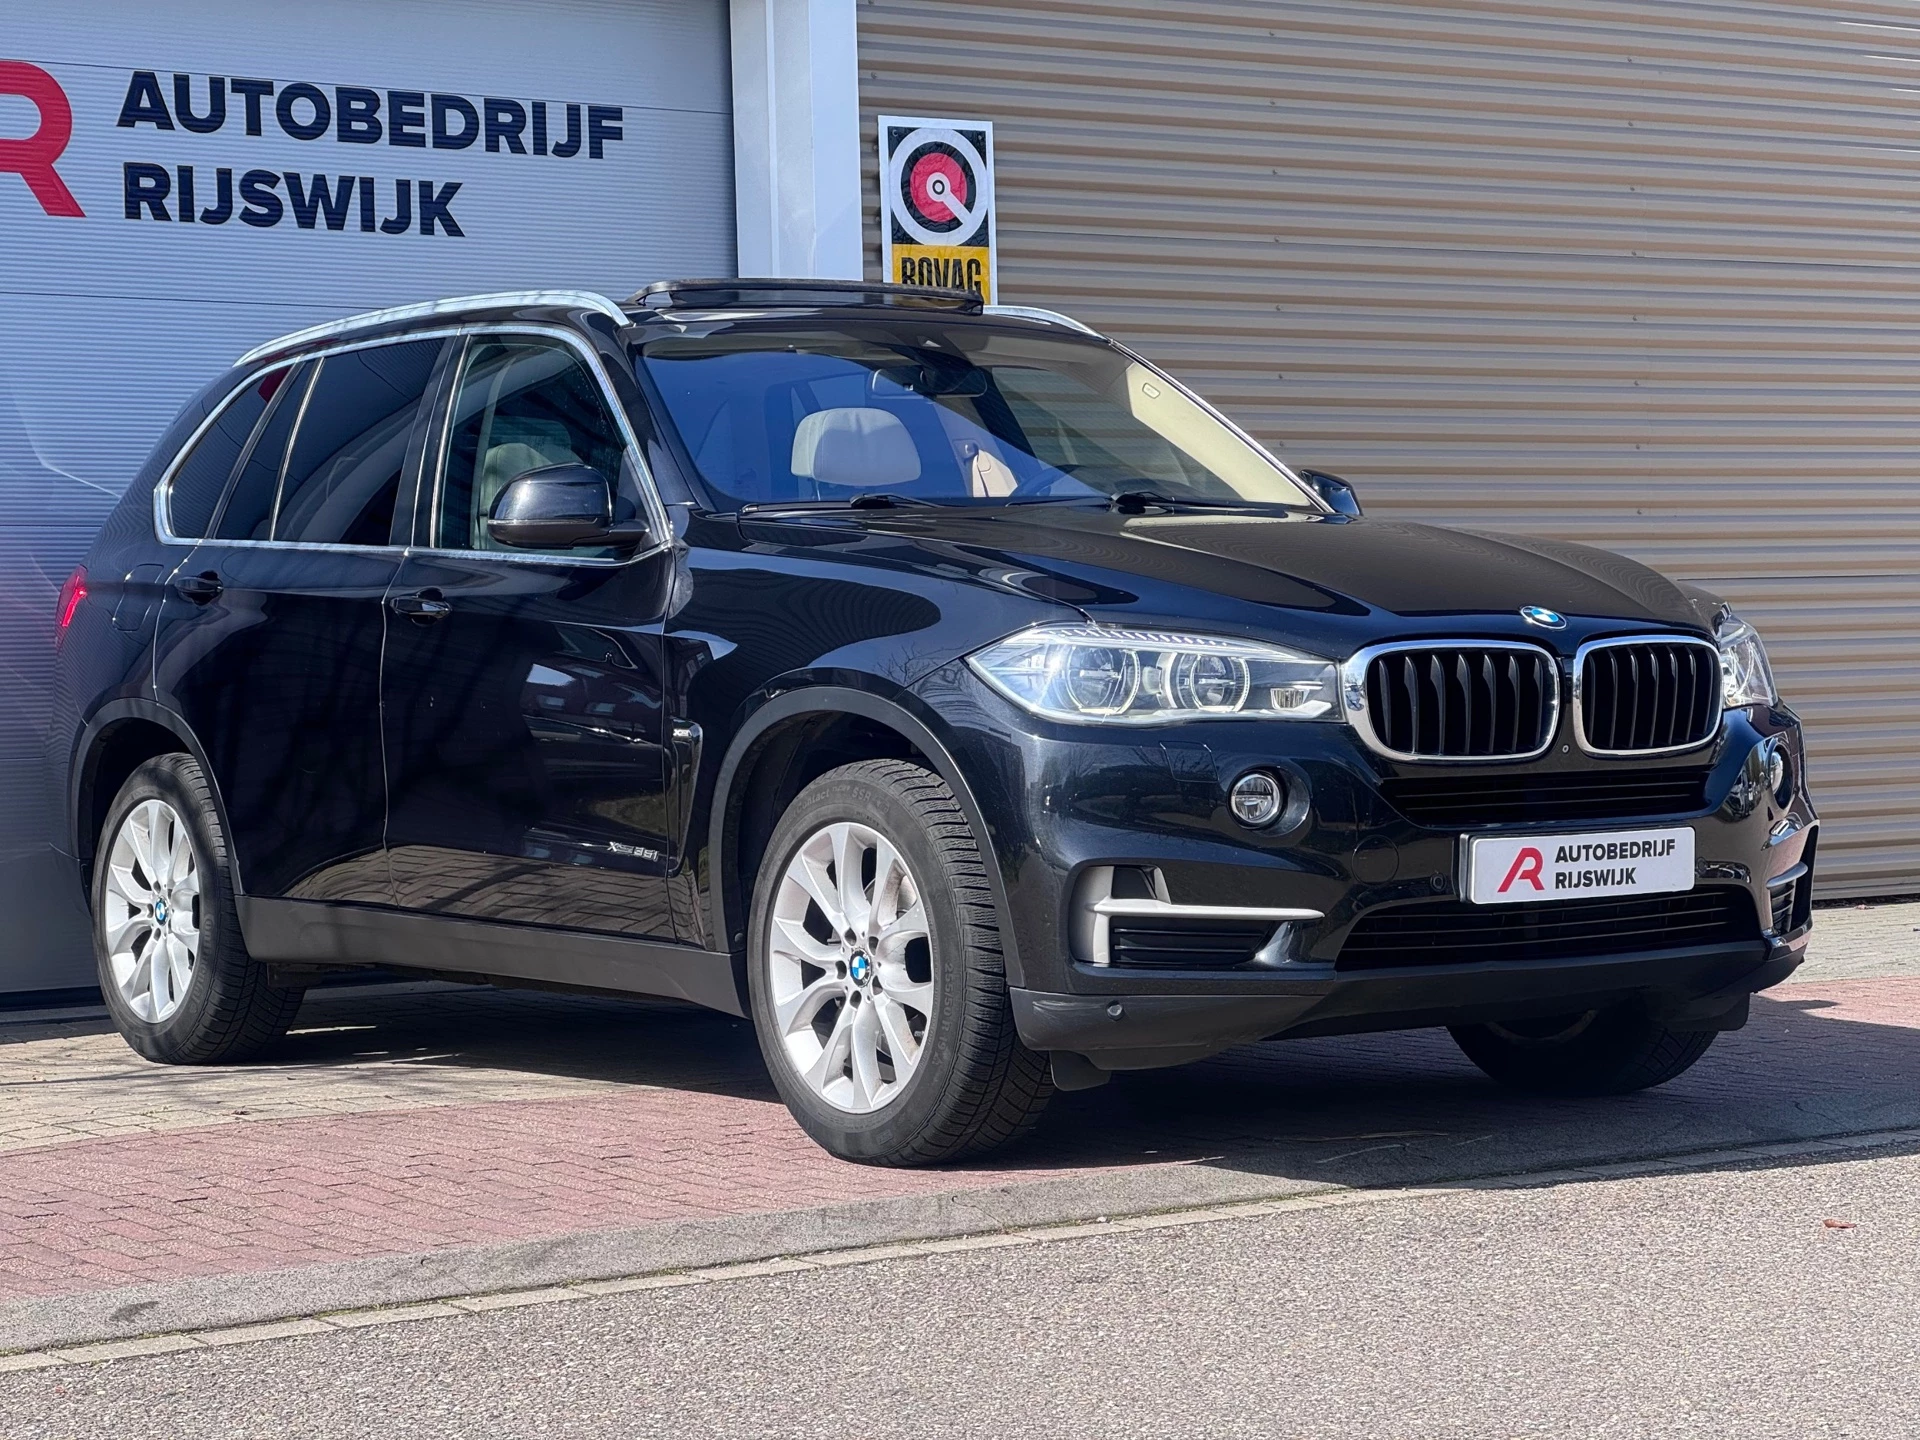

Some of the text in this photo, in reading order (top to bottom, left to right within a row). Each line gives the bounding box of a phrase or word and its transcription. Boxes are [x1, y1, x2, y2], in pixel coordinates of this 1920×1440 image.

[116, 70, 624, 160] AUTOBEDRIJF
[122, 161, 466, 237] RIJSWIJK
[901, 256, 982, 292] BOVAG
[1554, 838, 1676, 864] AUTOBEDRIJF
[1554, 867, 1637, 890] RIJSWIJK
